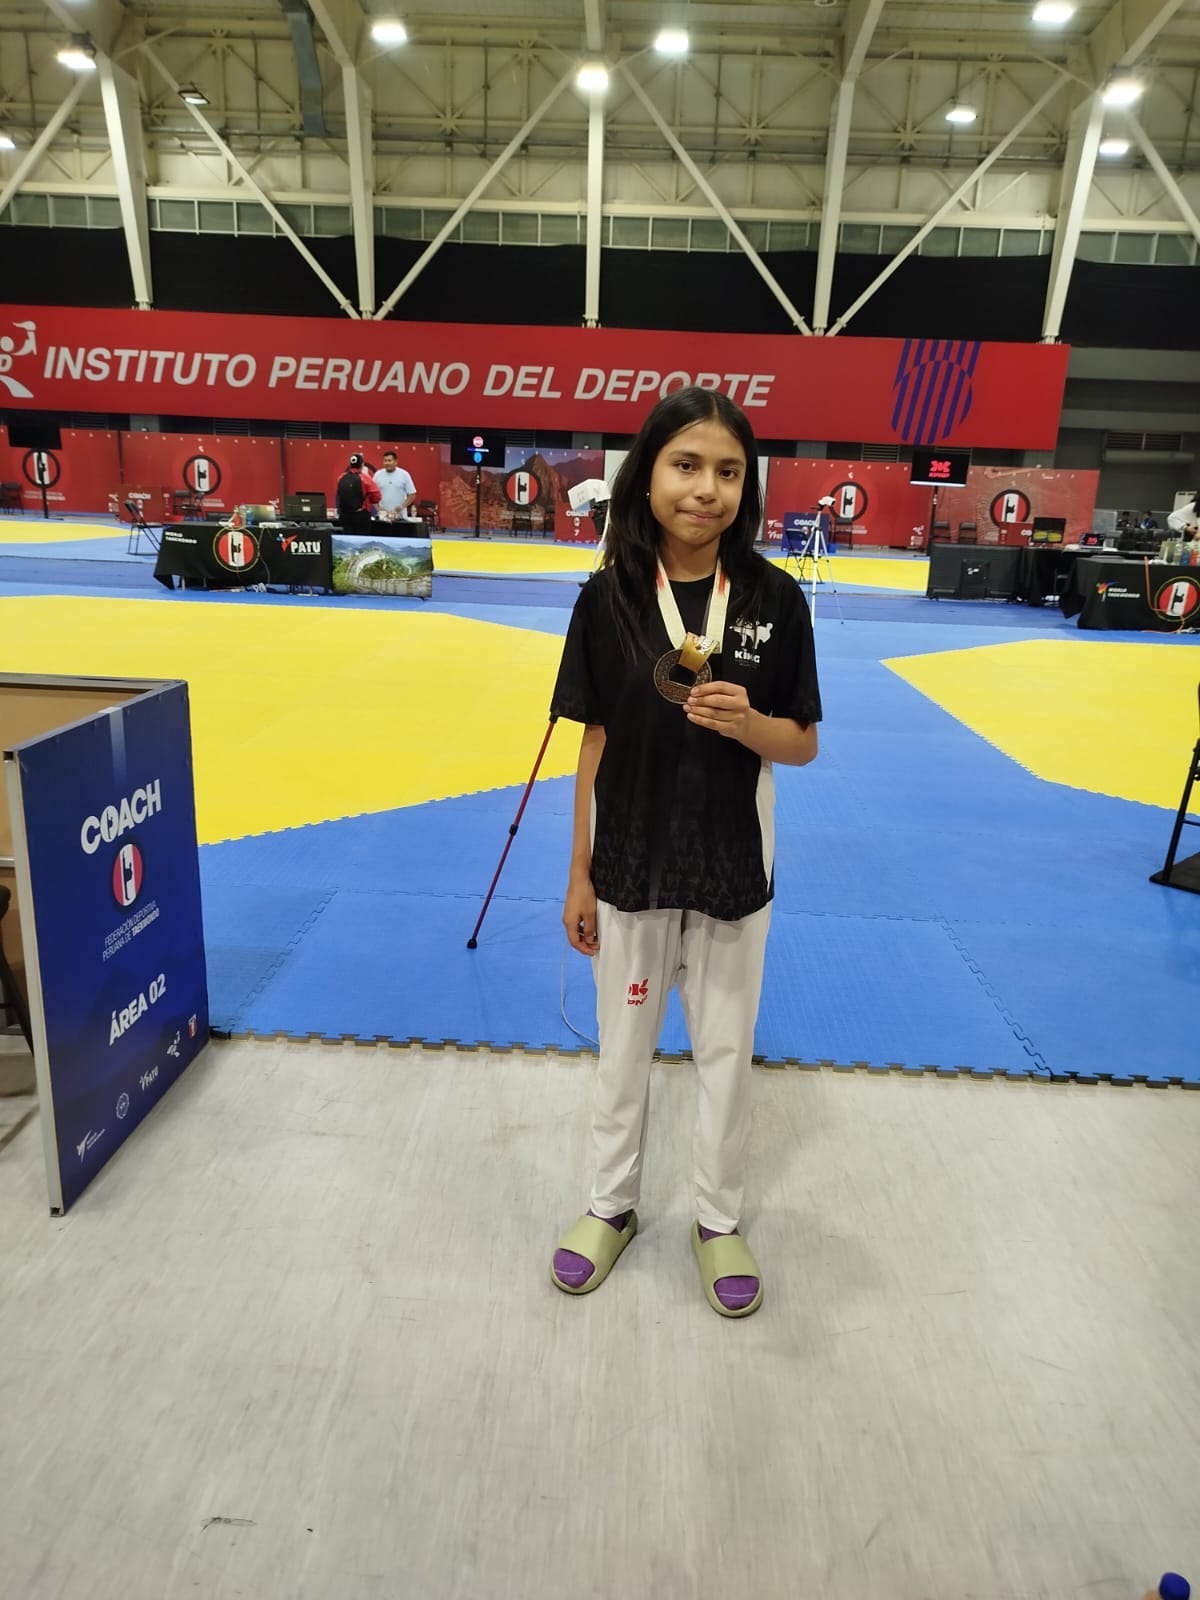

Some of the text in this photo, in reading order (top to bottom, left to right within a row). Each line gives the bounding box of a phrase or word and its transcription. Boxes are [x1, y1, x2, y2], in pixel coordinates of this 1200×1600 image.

[43, 346, 775, 407] INSTITUTO PERUANO DEL DEPORTE
[290, 541, 321, 553] PATU
[80, 778, 162, 855] COACH
[109, 973, 167, 1046] ÁREA 02
